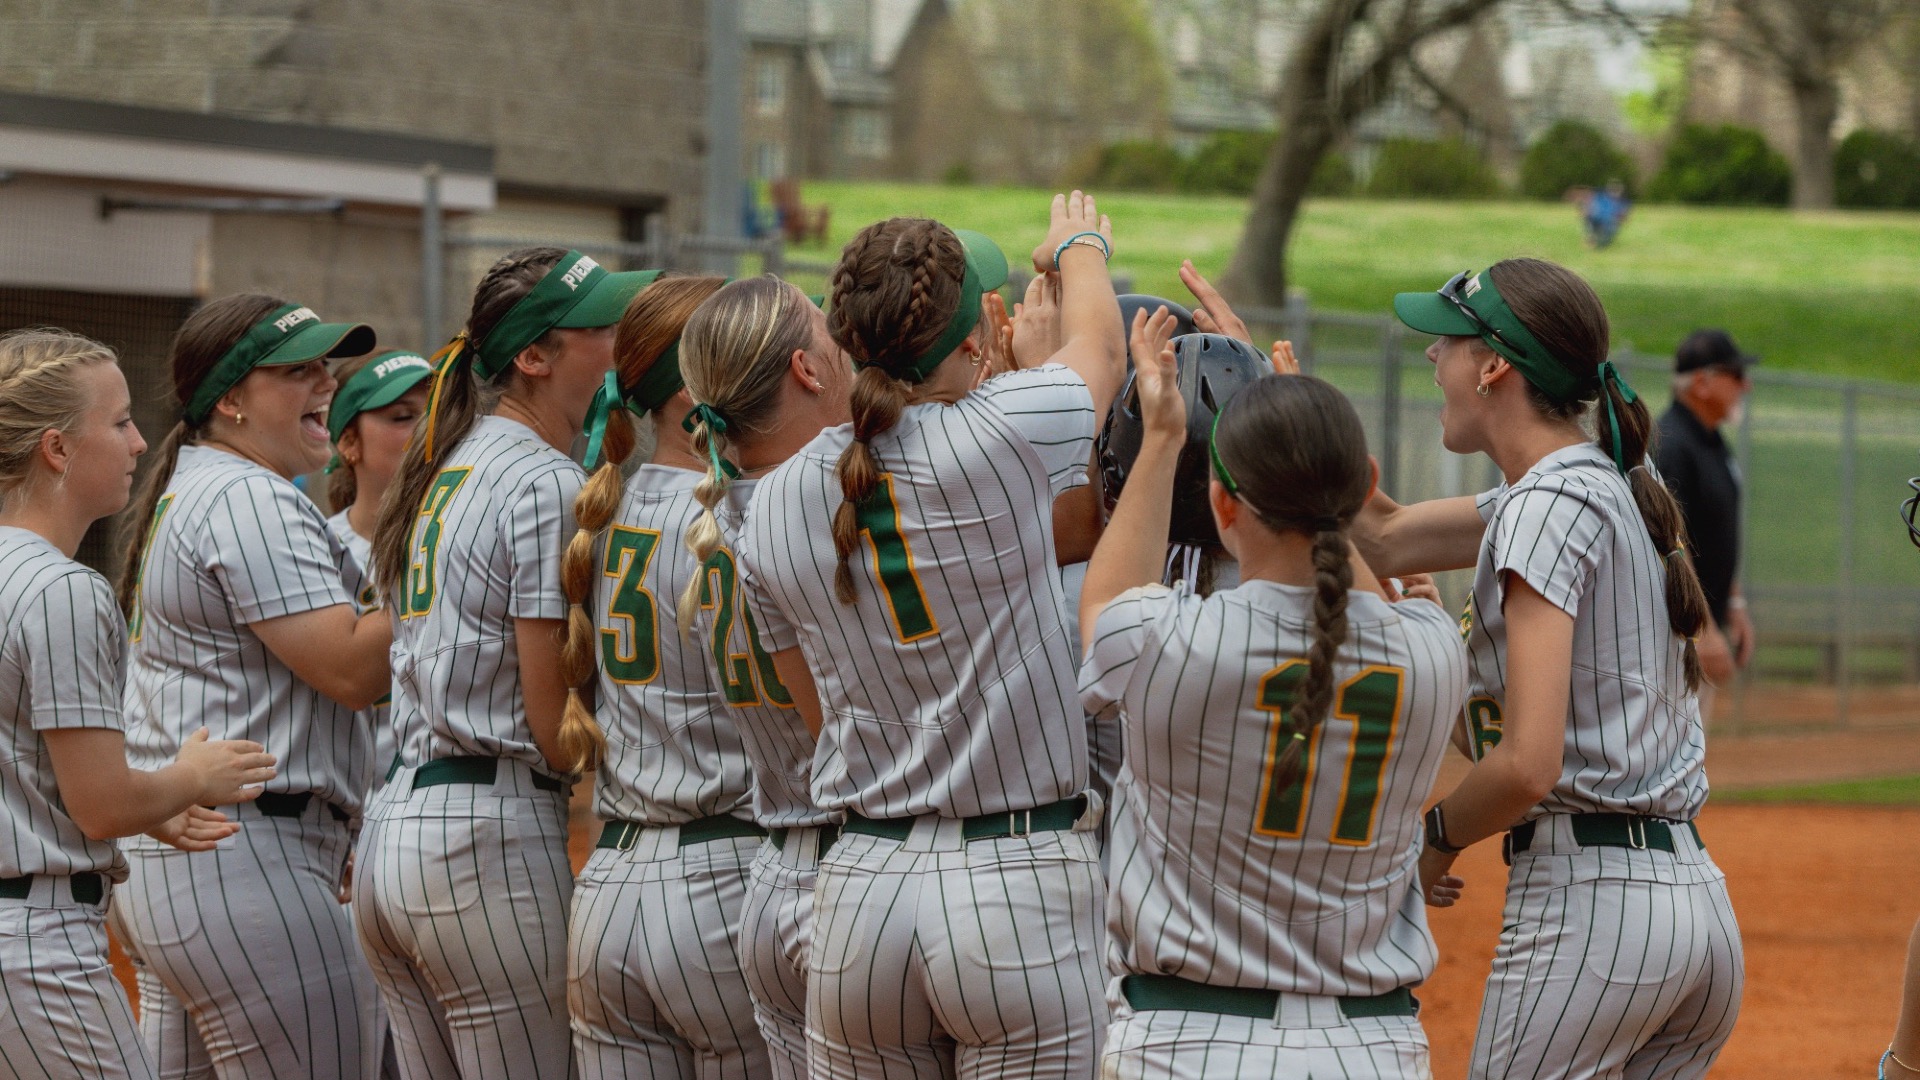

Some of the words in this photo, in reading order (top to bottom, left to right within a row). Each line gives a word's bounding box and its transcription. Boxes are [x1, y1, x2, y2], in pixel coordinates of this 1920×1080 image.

[600, 524, 662, 686] 3
[856, 471, 940, 645] 1
[1254, 657, 1405, 847] 11
